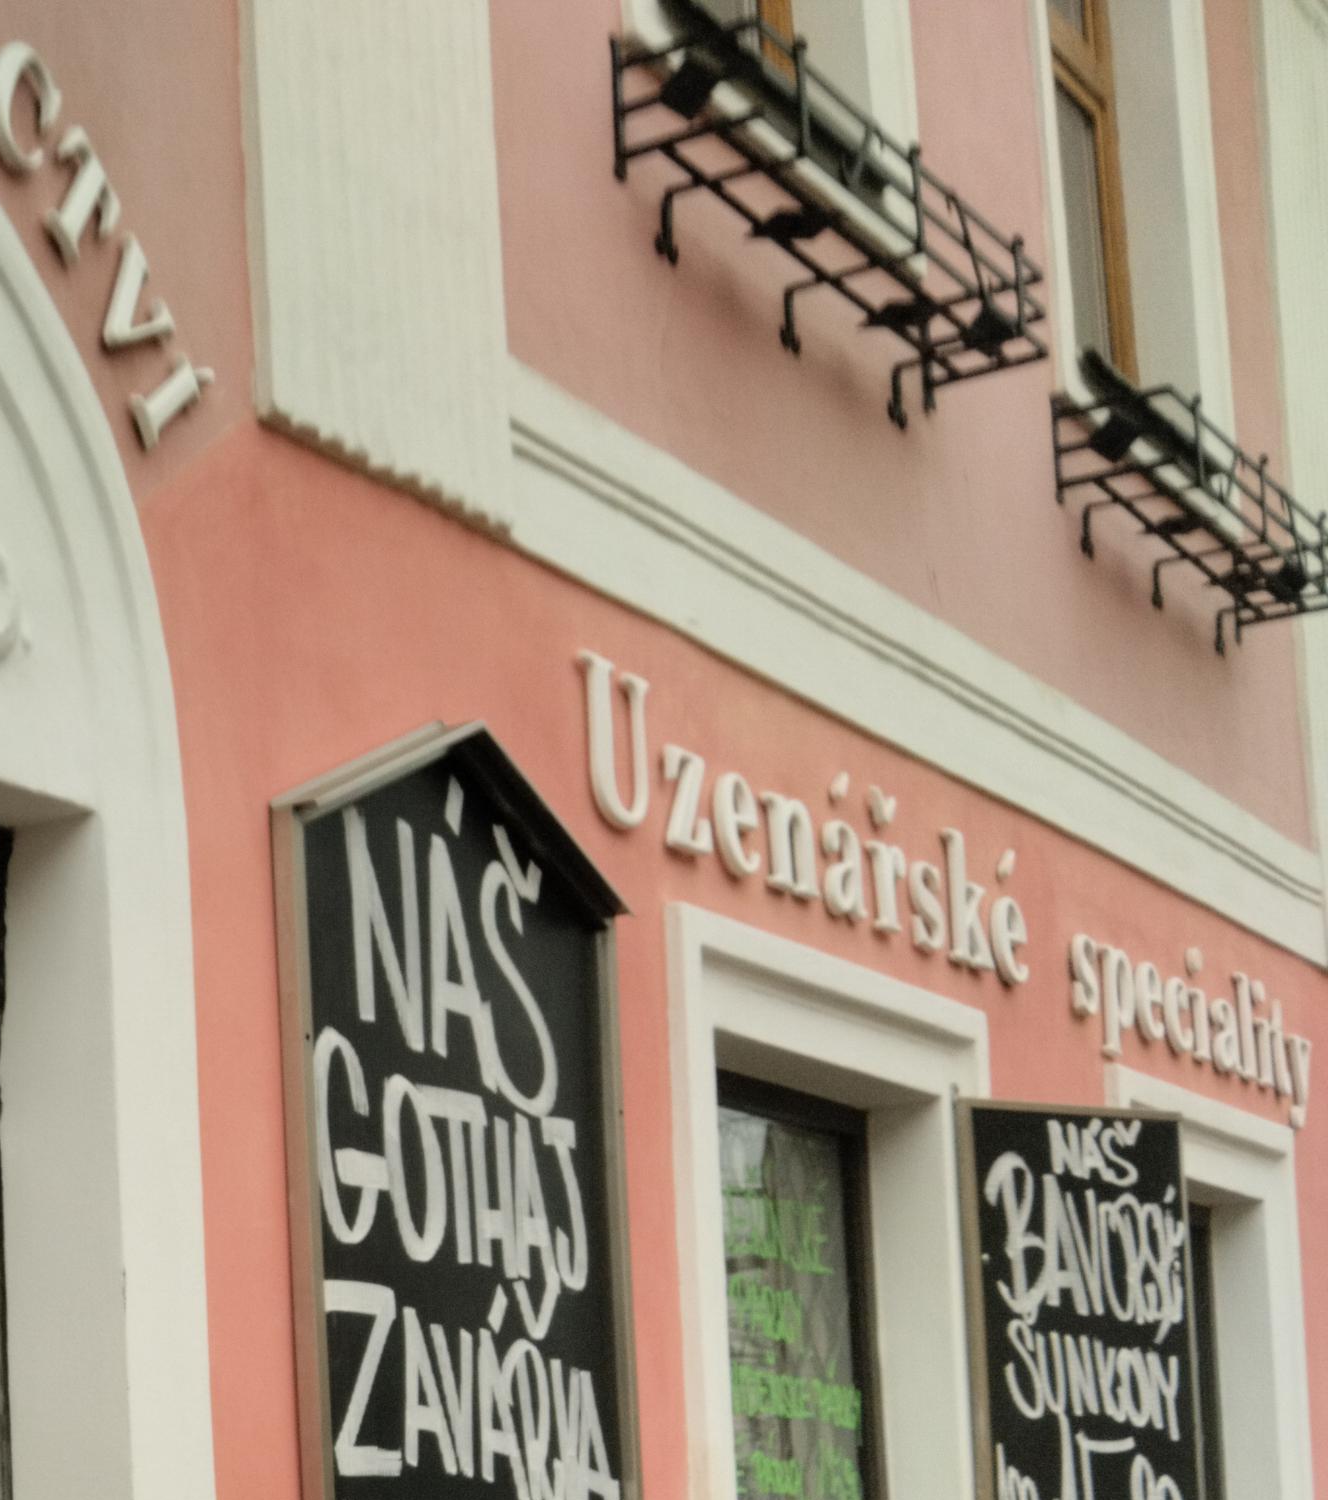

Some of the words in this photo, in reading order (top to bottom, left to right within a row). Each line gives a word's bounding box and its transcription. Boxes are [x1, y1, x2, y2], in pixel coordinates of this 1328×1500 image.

[343, 774, 558, 1117] NÁŠ
[576, 649, 1030, 985] Uzenářské
[1070, 932, 1312, 1130] speciality
[313, 1026, 589, 1293] GOTHAJ
[1046, 1117, 1142, 1187] NÁŠ
